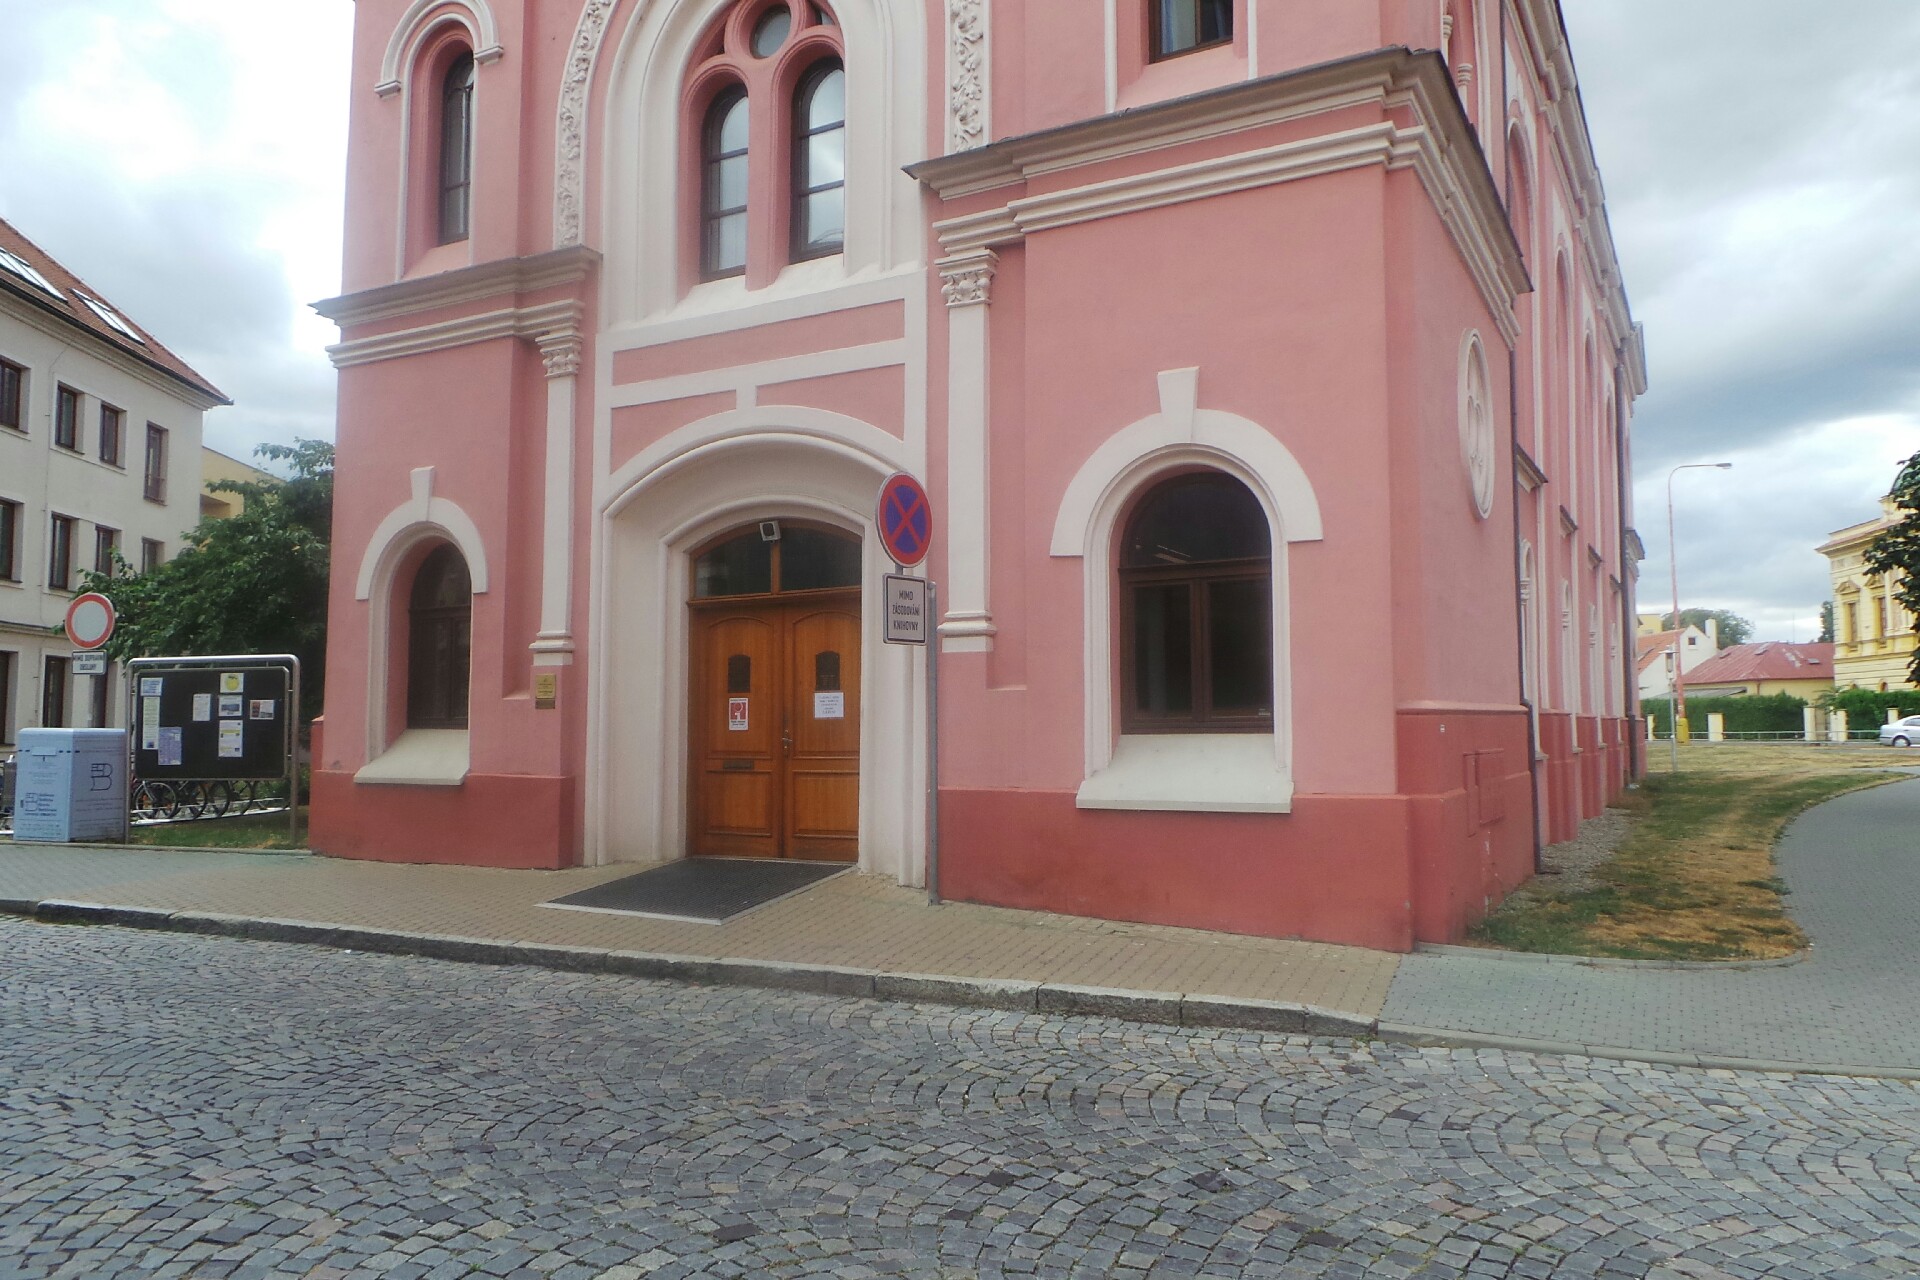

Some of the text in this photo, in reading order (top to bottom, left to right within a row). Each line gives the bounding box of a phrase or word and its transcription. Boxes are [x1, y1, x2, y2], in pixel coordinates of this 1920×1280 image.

[899, 590, 914, 601] MIMO
[892, 602, 920, 616] ZÁSOBOVÁNÍ
[893, 619, 919, 631] KNIHOVNY
